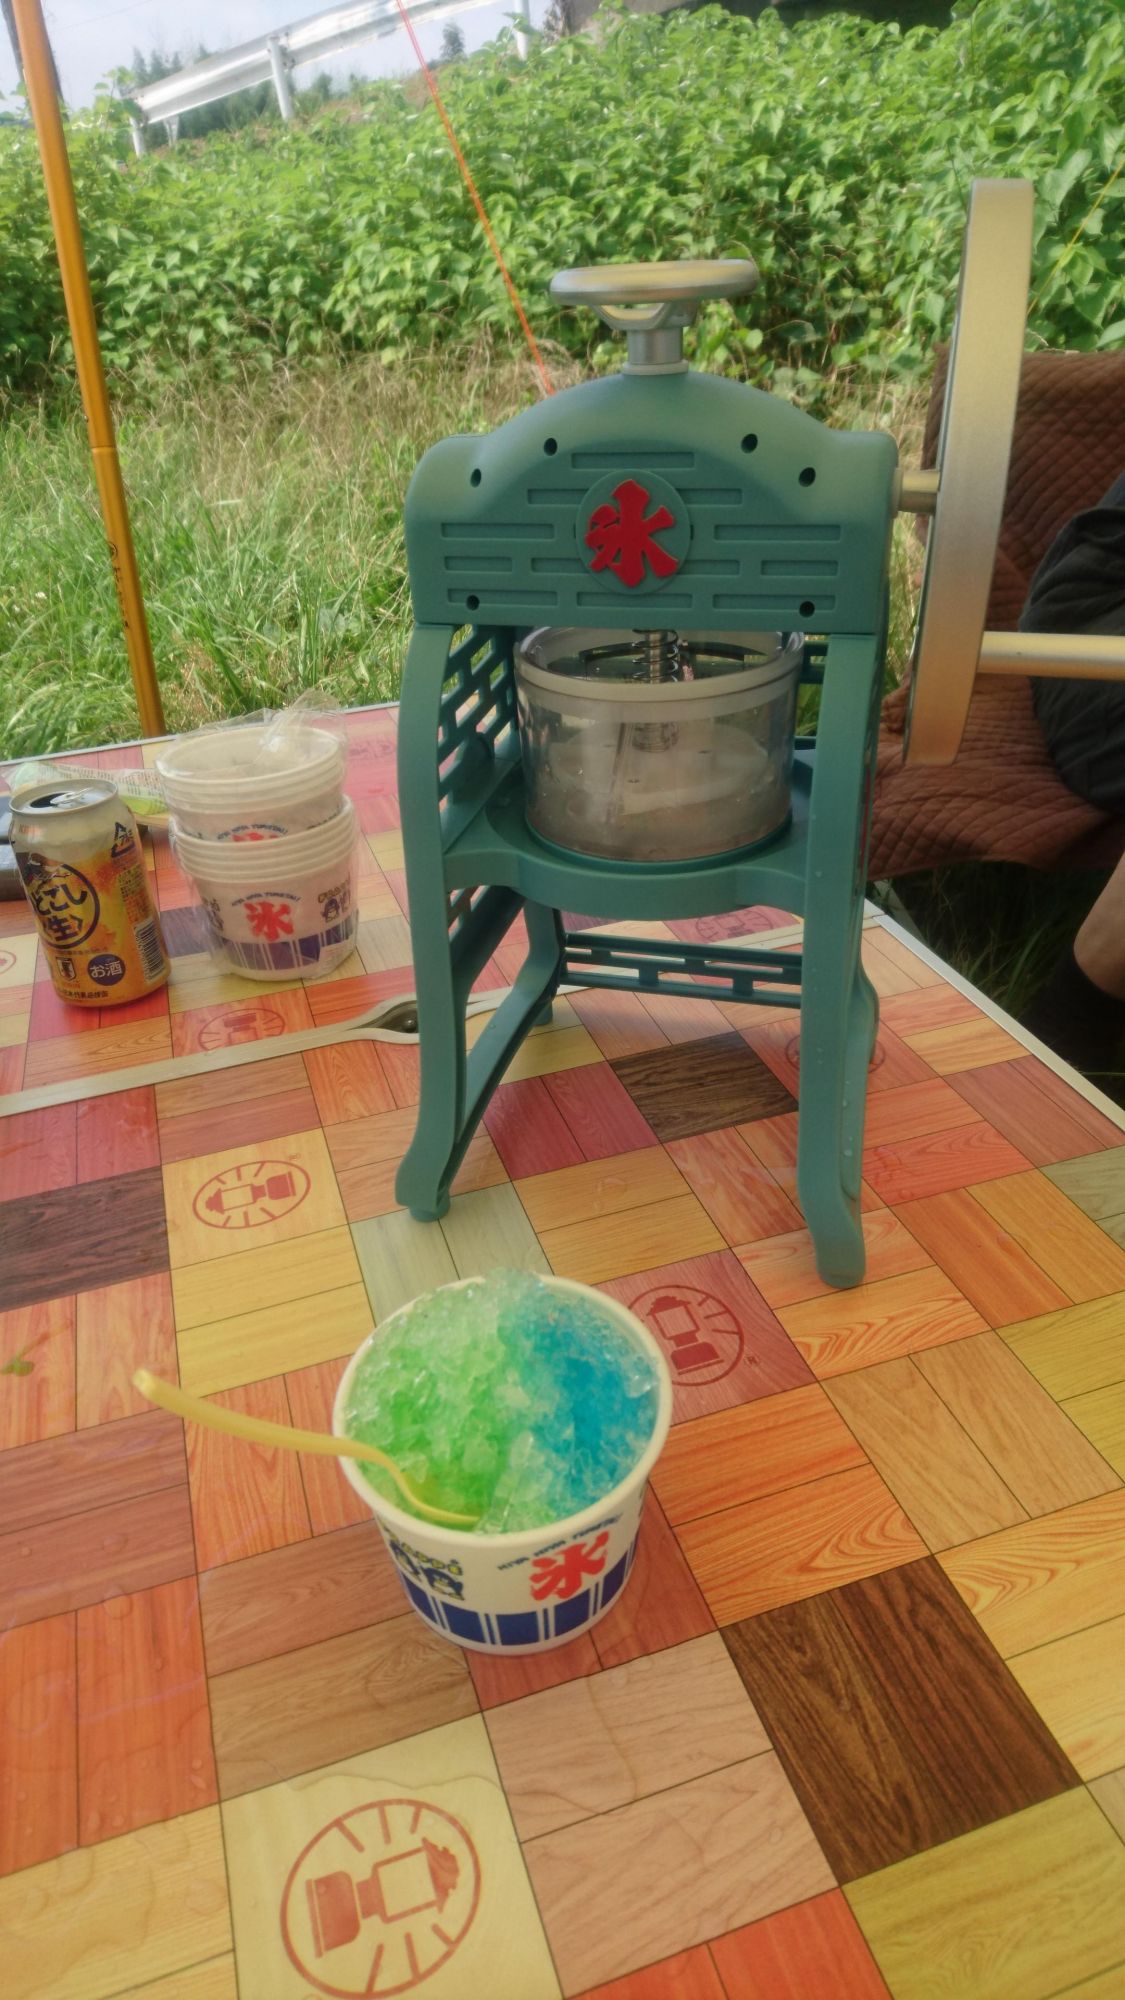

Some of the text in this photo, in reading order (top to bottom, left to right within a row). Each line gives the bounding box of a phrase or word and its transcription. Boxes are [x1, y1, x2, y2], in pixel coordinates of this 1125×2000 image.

[585, 479, 679, 588] 氷
[244, 901, 294, 941] 氷
[90, 960, 123, 979] お酒
[529, 1530, 610, 1601] 氷
